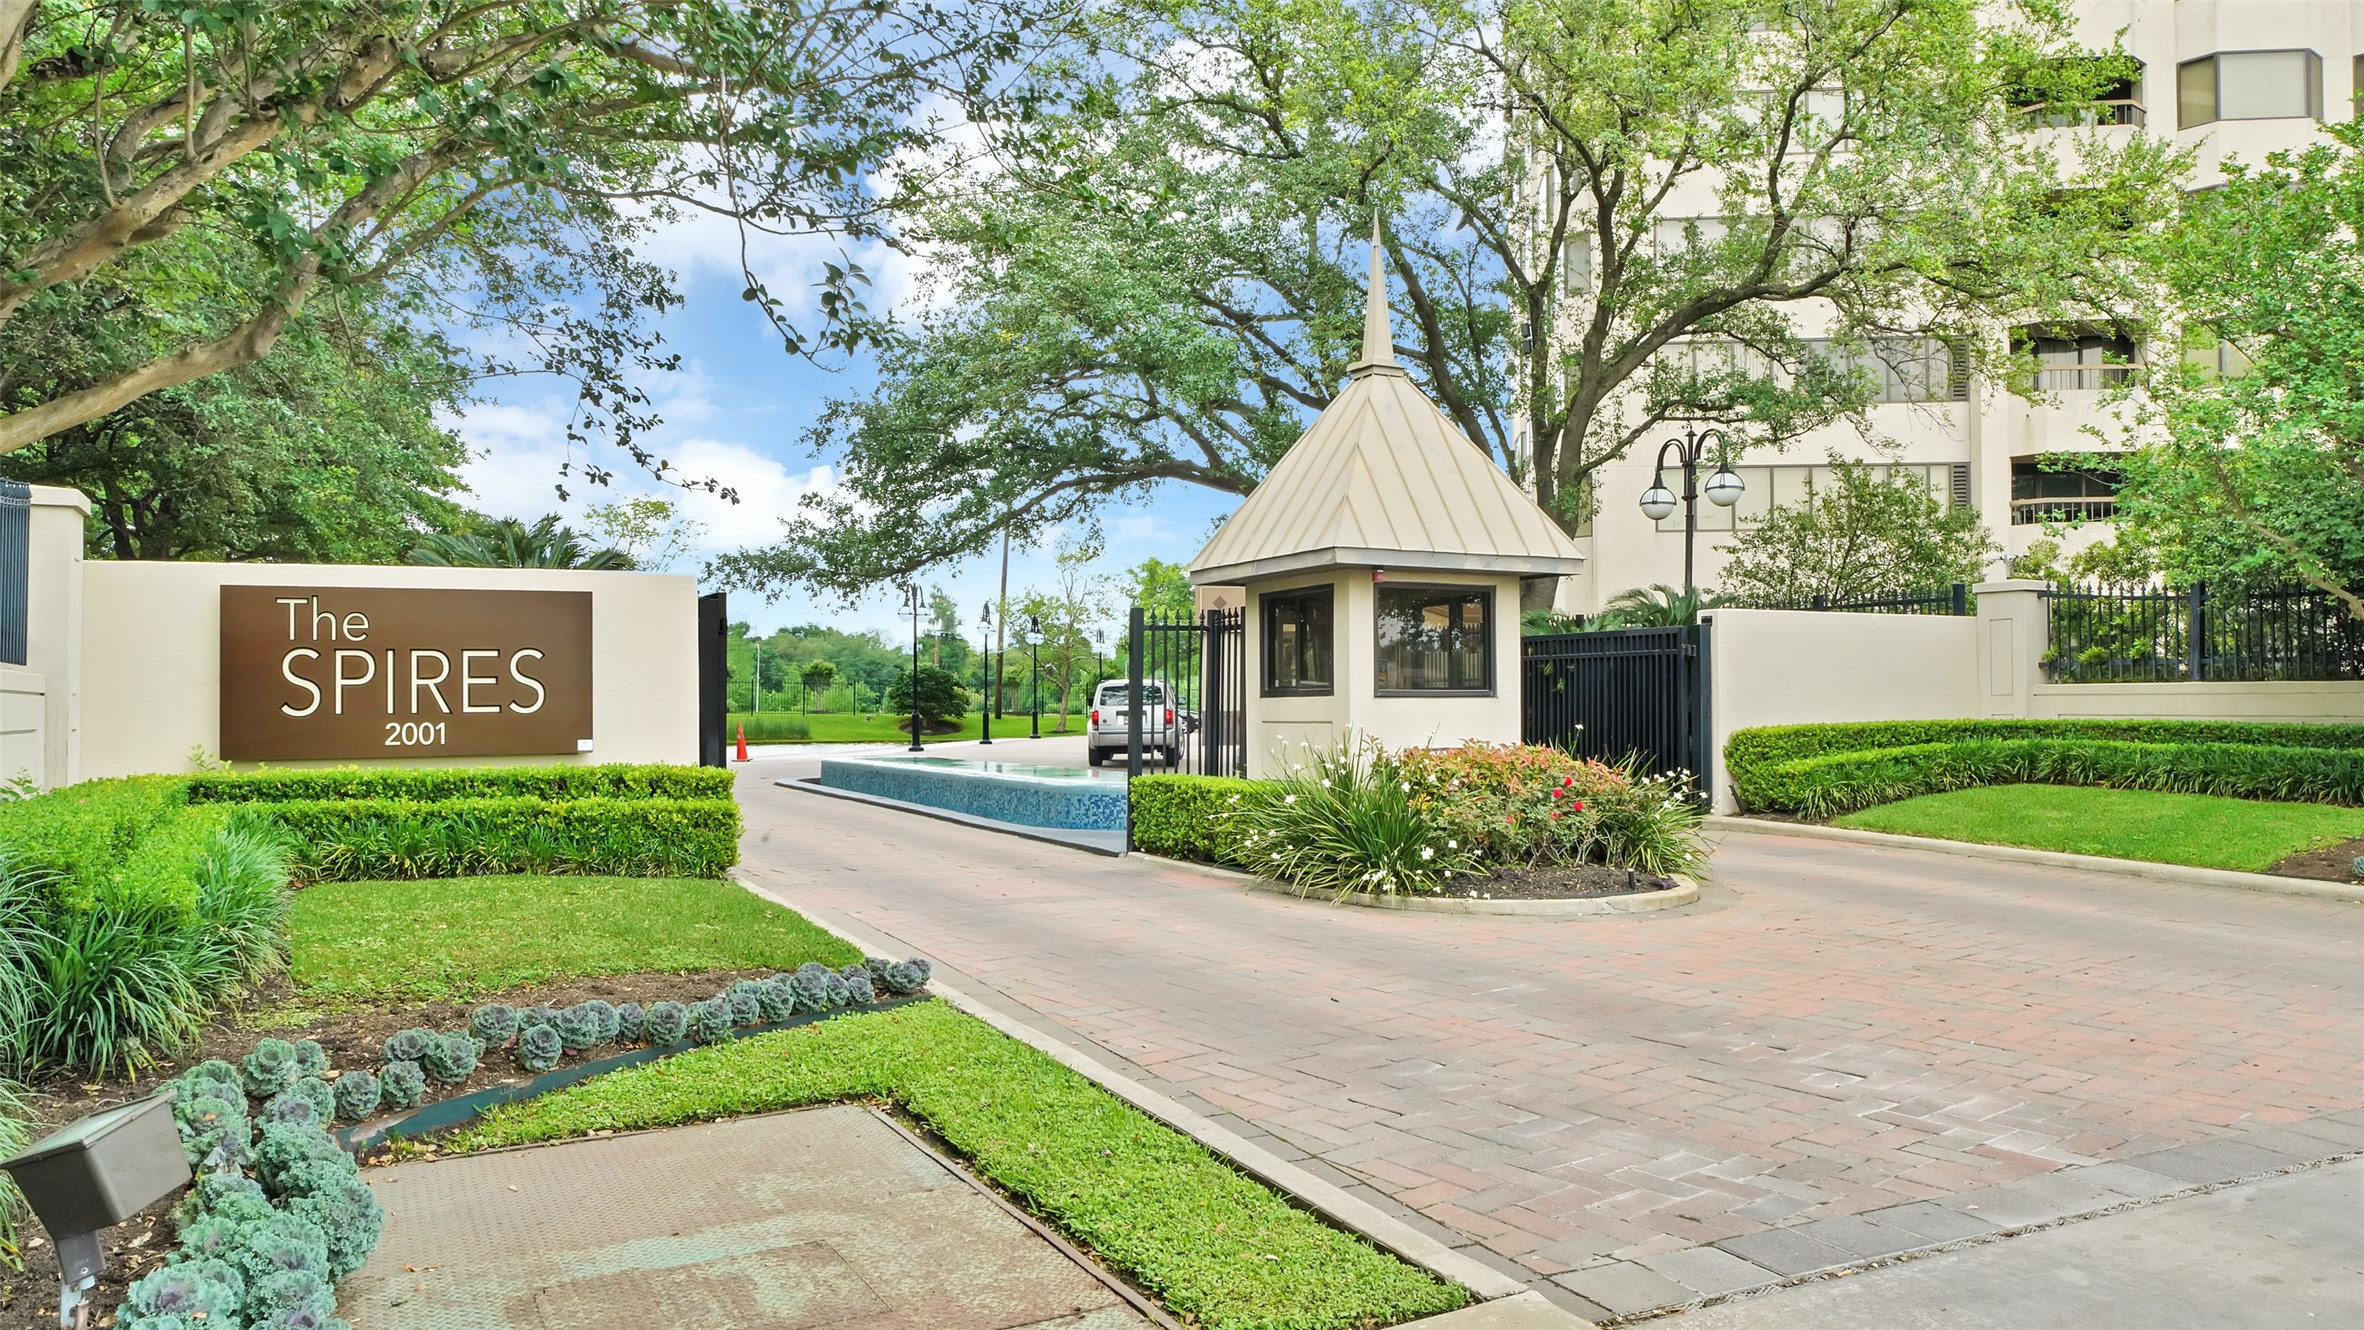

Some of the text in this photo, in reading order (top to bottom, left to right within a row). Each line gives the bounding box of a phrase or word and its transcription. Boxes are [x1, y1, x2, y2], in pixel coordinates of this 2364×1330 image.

[276, 595, 369, 641] The
[280, 647, 546, 717] SPIRES
[385, 722, 446, 746] 2001
